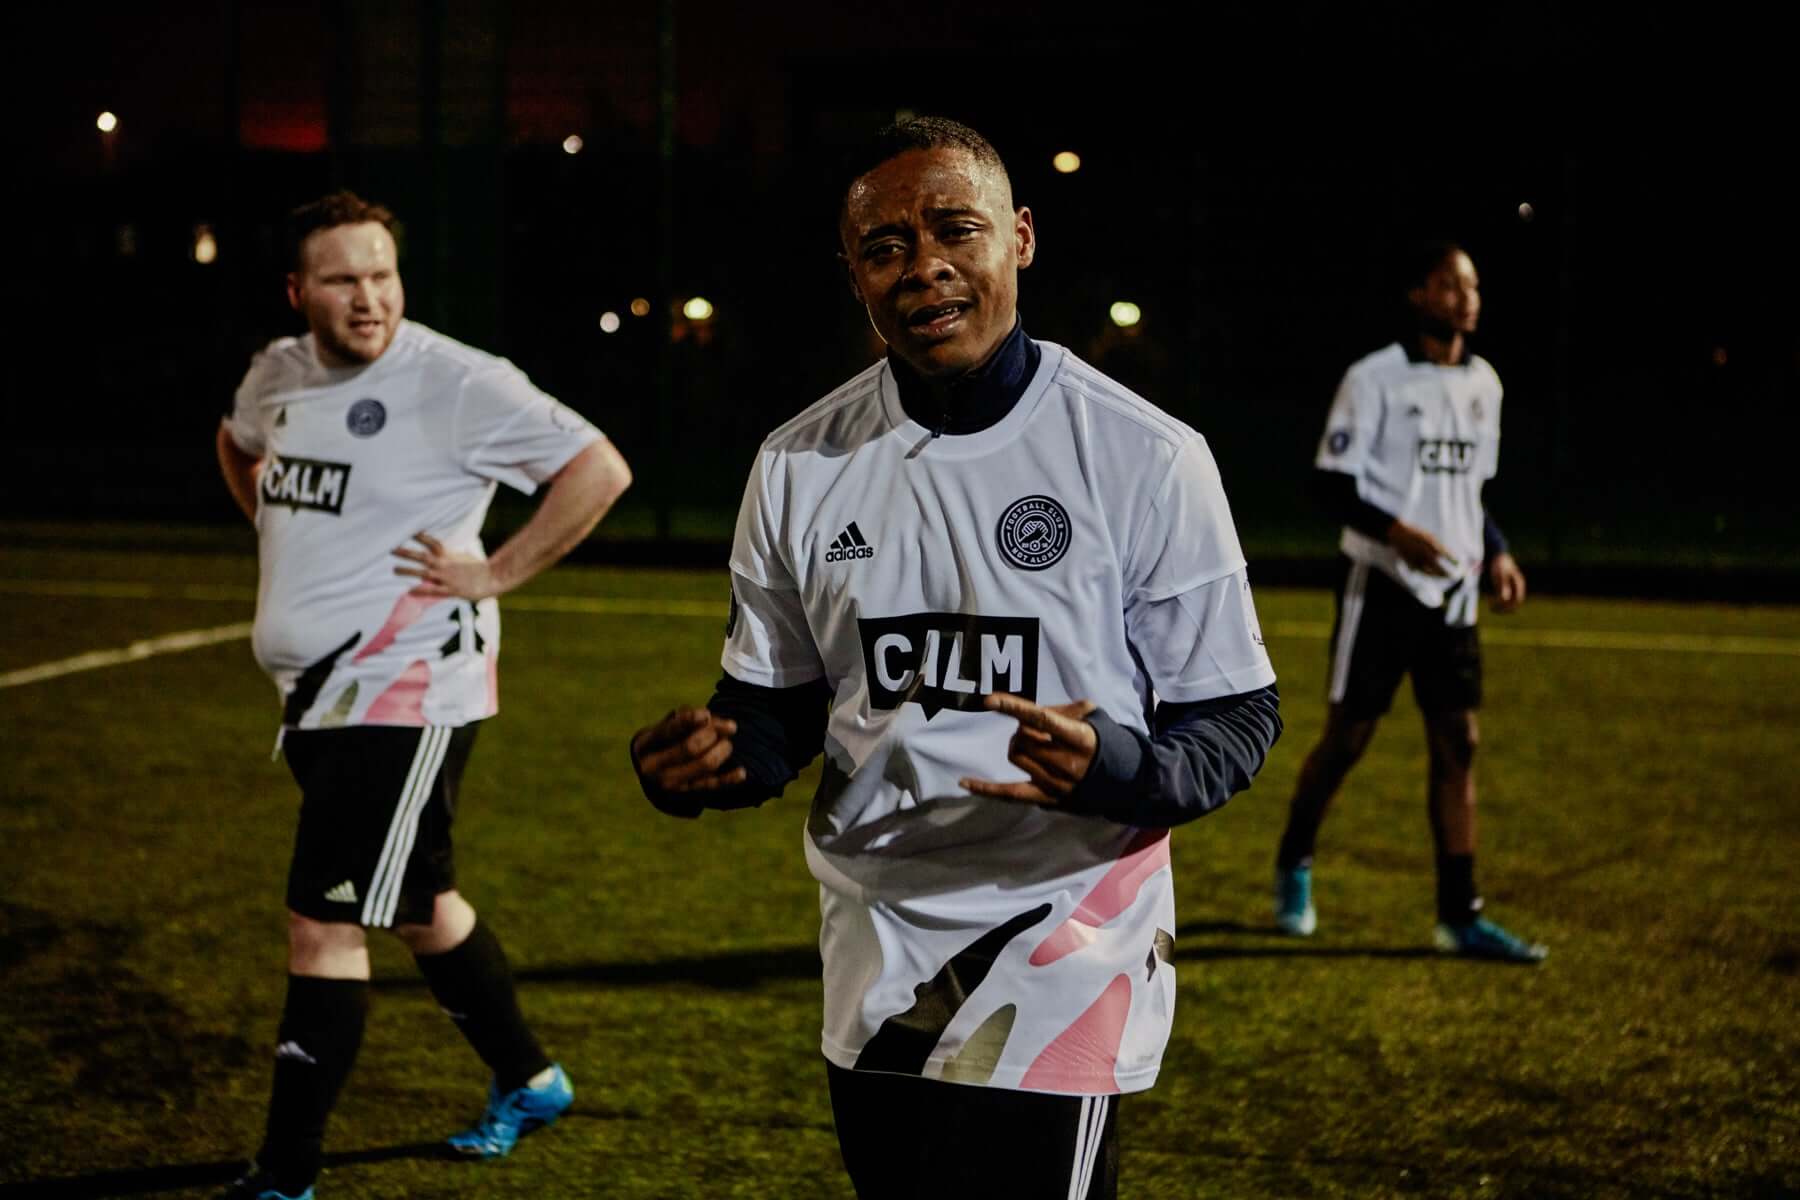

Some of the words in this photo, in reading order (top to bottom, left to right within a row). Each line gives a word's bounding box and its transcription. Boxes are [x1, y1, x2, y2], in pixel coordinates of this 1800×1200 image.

[265, 464, 344, 507] CALM
[1006, 503, 1046, 530] FOOTBALL
[1048, 507, 1064, 529] CLUB
[825, 546, 874, 562] adidas
[1011, 547, 1028, 562] NOT
[1030, 548, 1058, 563] ALONE
